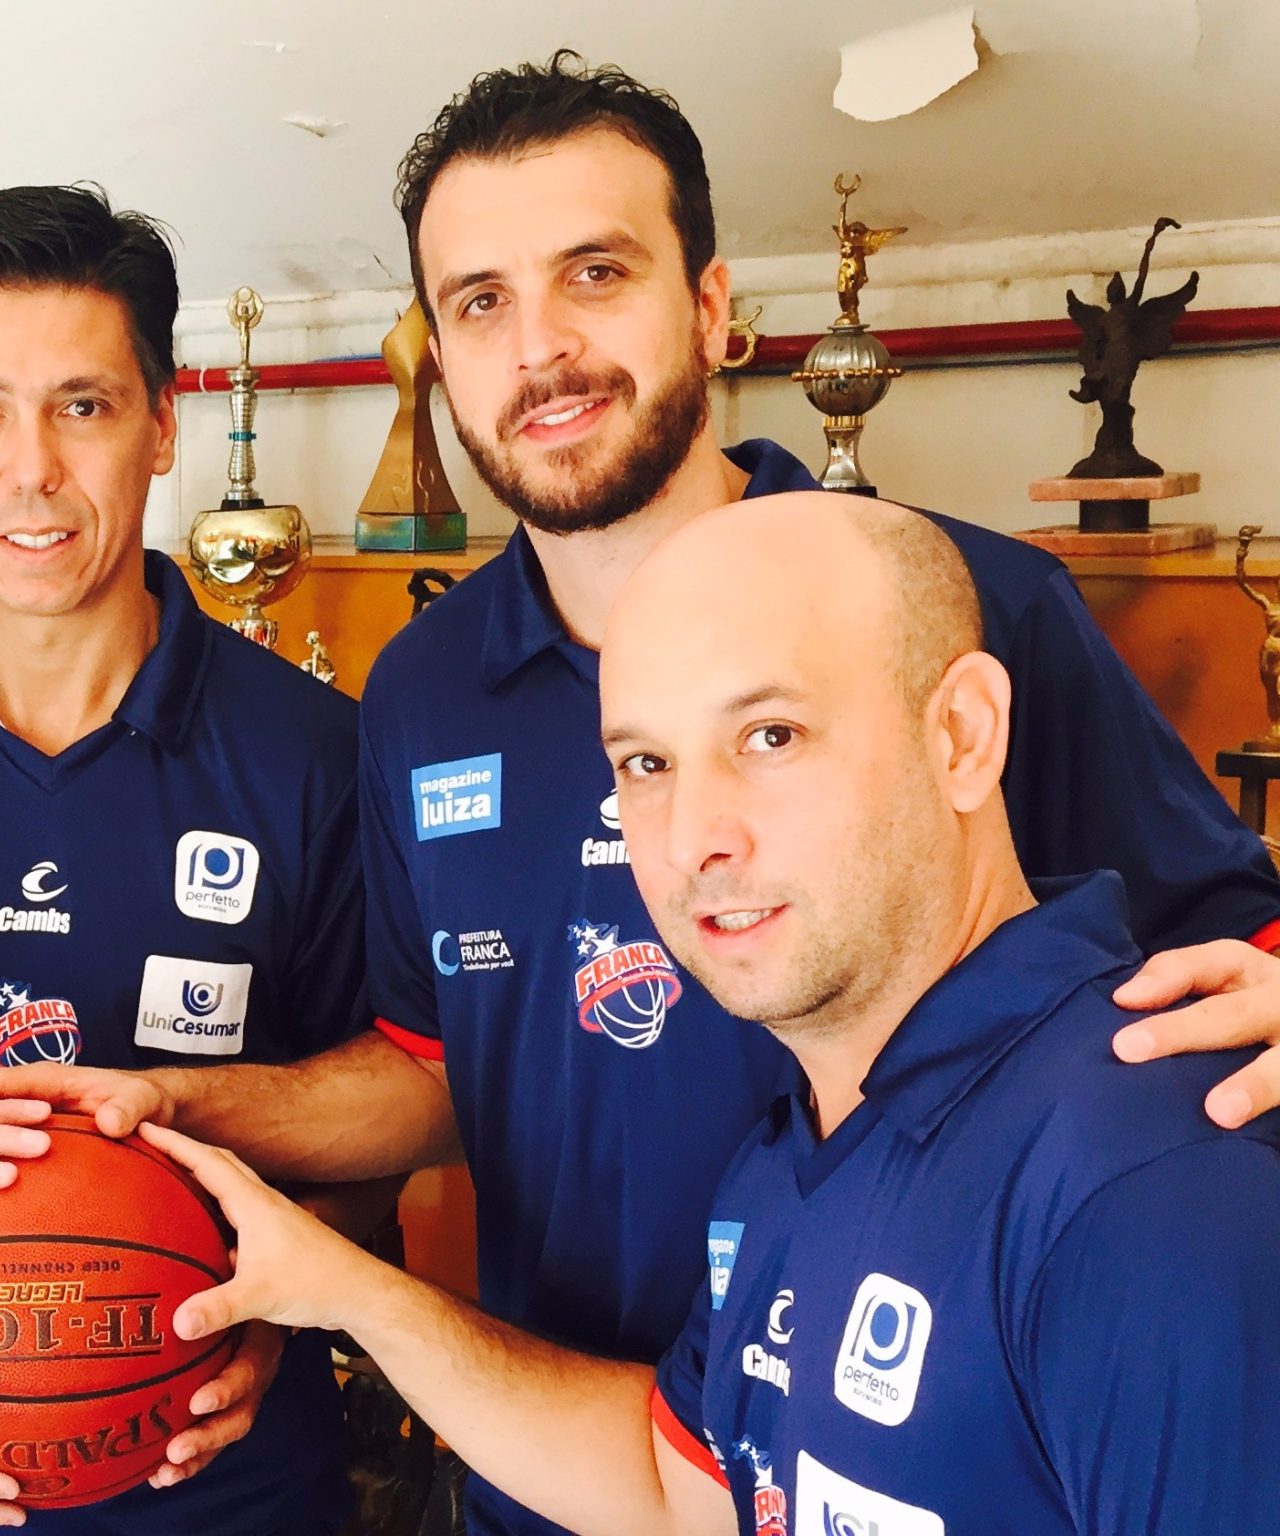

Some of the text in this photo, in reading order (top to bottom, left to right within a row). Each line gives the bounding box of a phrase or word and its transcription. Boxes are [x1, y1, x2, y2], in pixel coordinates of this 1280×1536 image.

[420, 769, 492, 794] magazine
[422, 792, 491, 828] luiza
[581, 838, 631, 867] Cam
[185, 891, 240, 909] perfetto
[459, 930, 502, 944] PREFEITURA
[461, 942, 510, 961] FRANCA
[576, 943, 672, 1001] FRANCA
[142, 1011, 241, 1037] UniCesumar
[1, 1261, 75, 1274] CHANNEL
[83, 1260, 121, 1272] DEEP
[843, 1365, 899, 1401] perfetto
